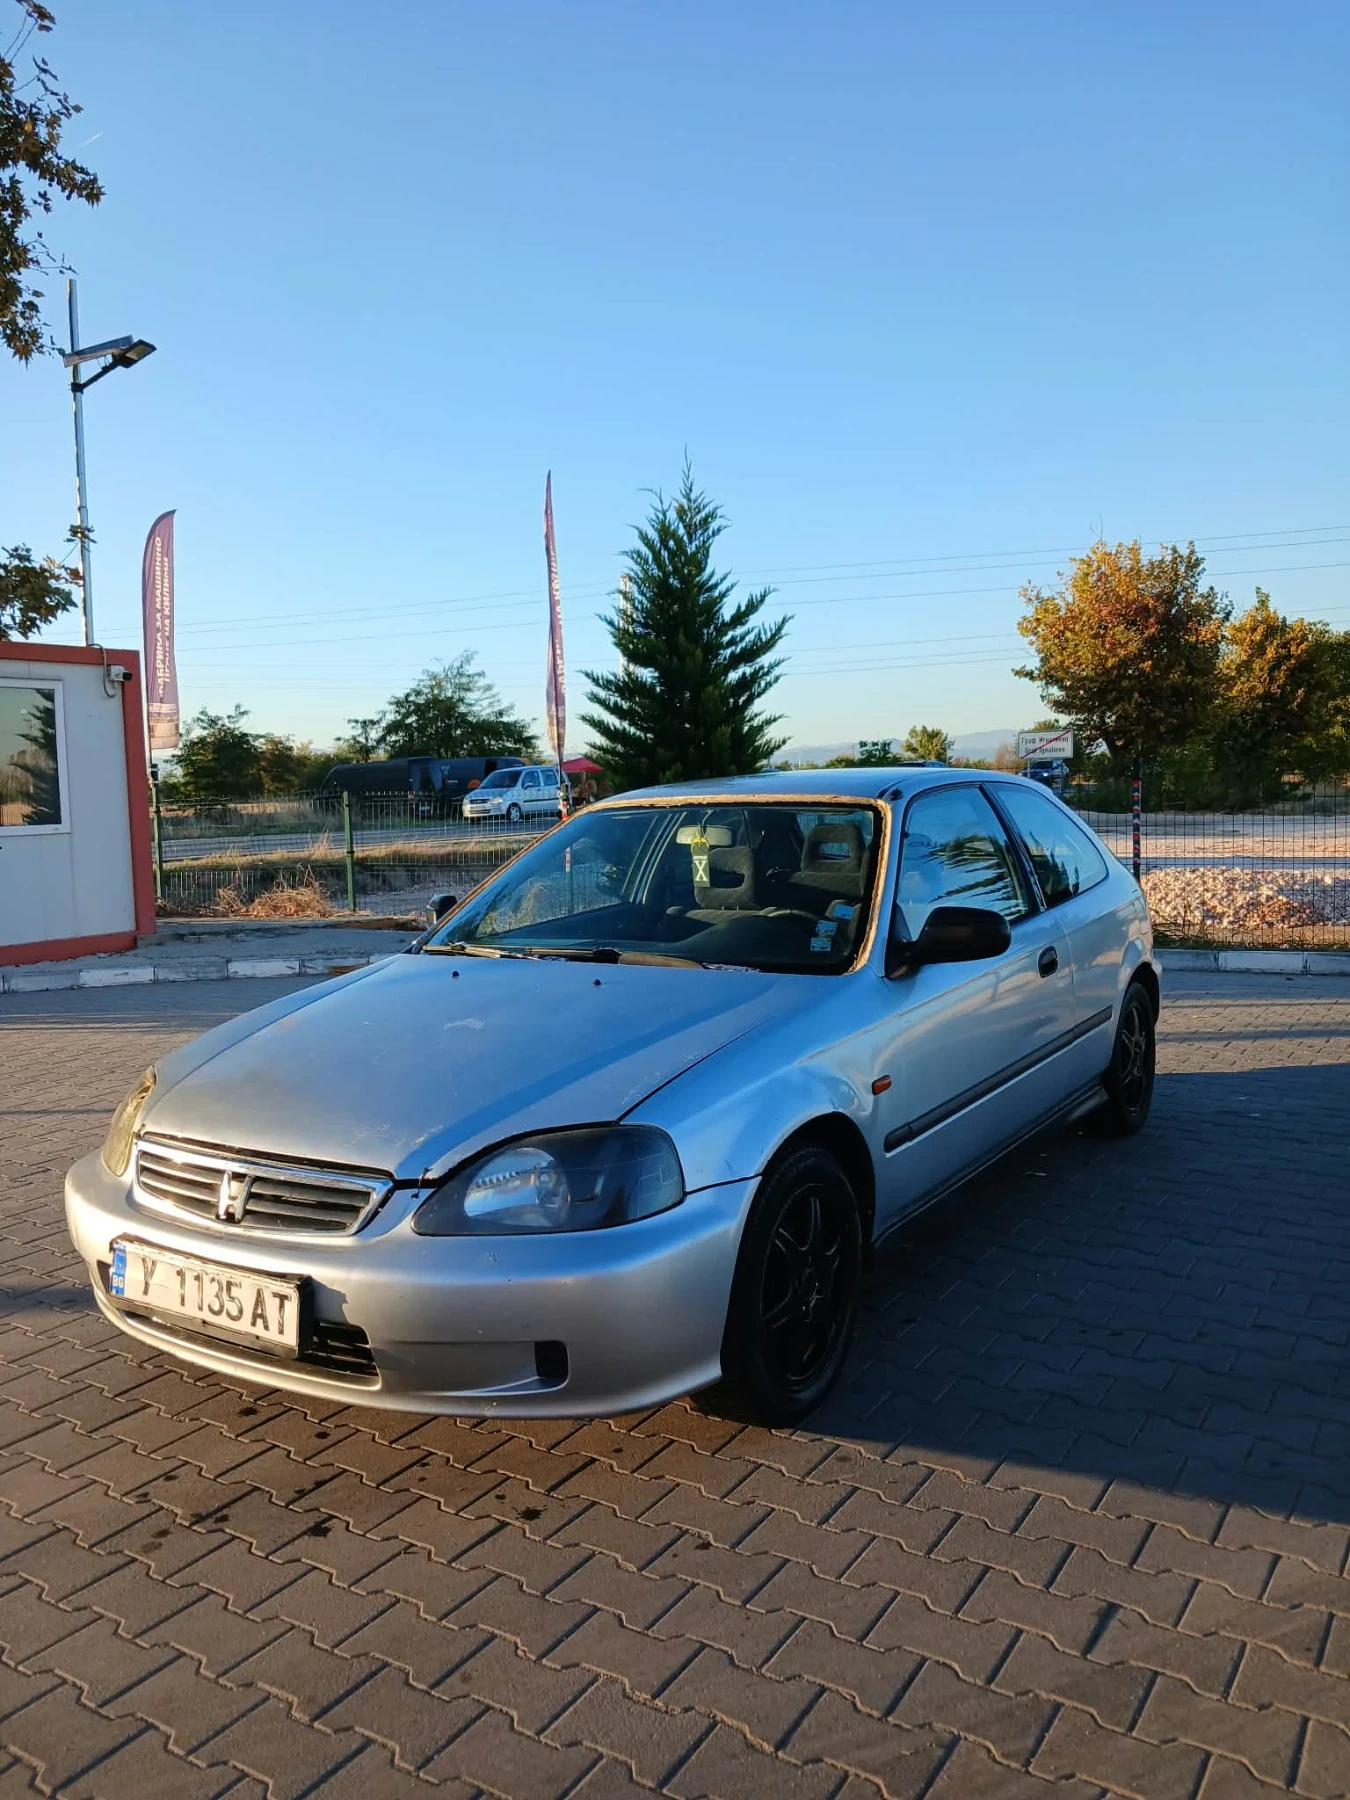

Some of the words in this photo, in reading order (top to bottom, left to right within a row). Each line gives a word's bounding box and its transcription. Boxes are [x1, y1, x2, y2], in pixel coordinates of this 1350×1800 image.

[154, 536, 162, 609] МАШИННО
[163, 556, 171, 615] КИЛИМИ
[155, 612, 162, 631] ЗА
[164, 619, 170, 636] НА
[112, 1275, 124, 1288] BG
[176, 1266, 244, 1322] 1135
[250, 1286, 292, 1336] AT
